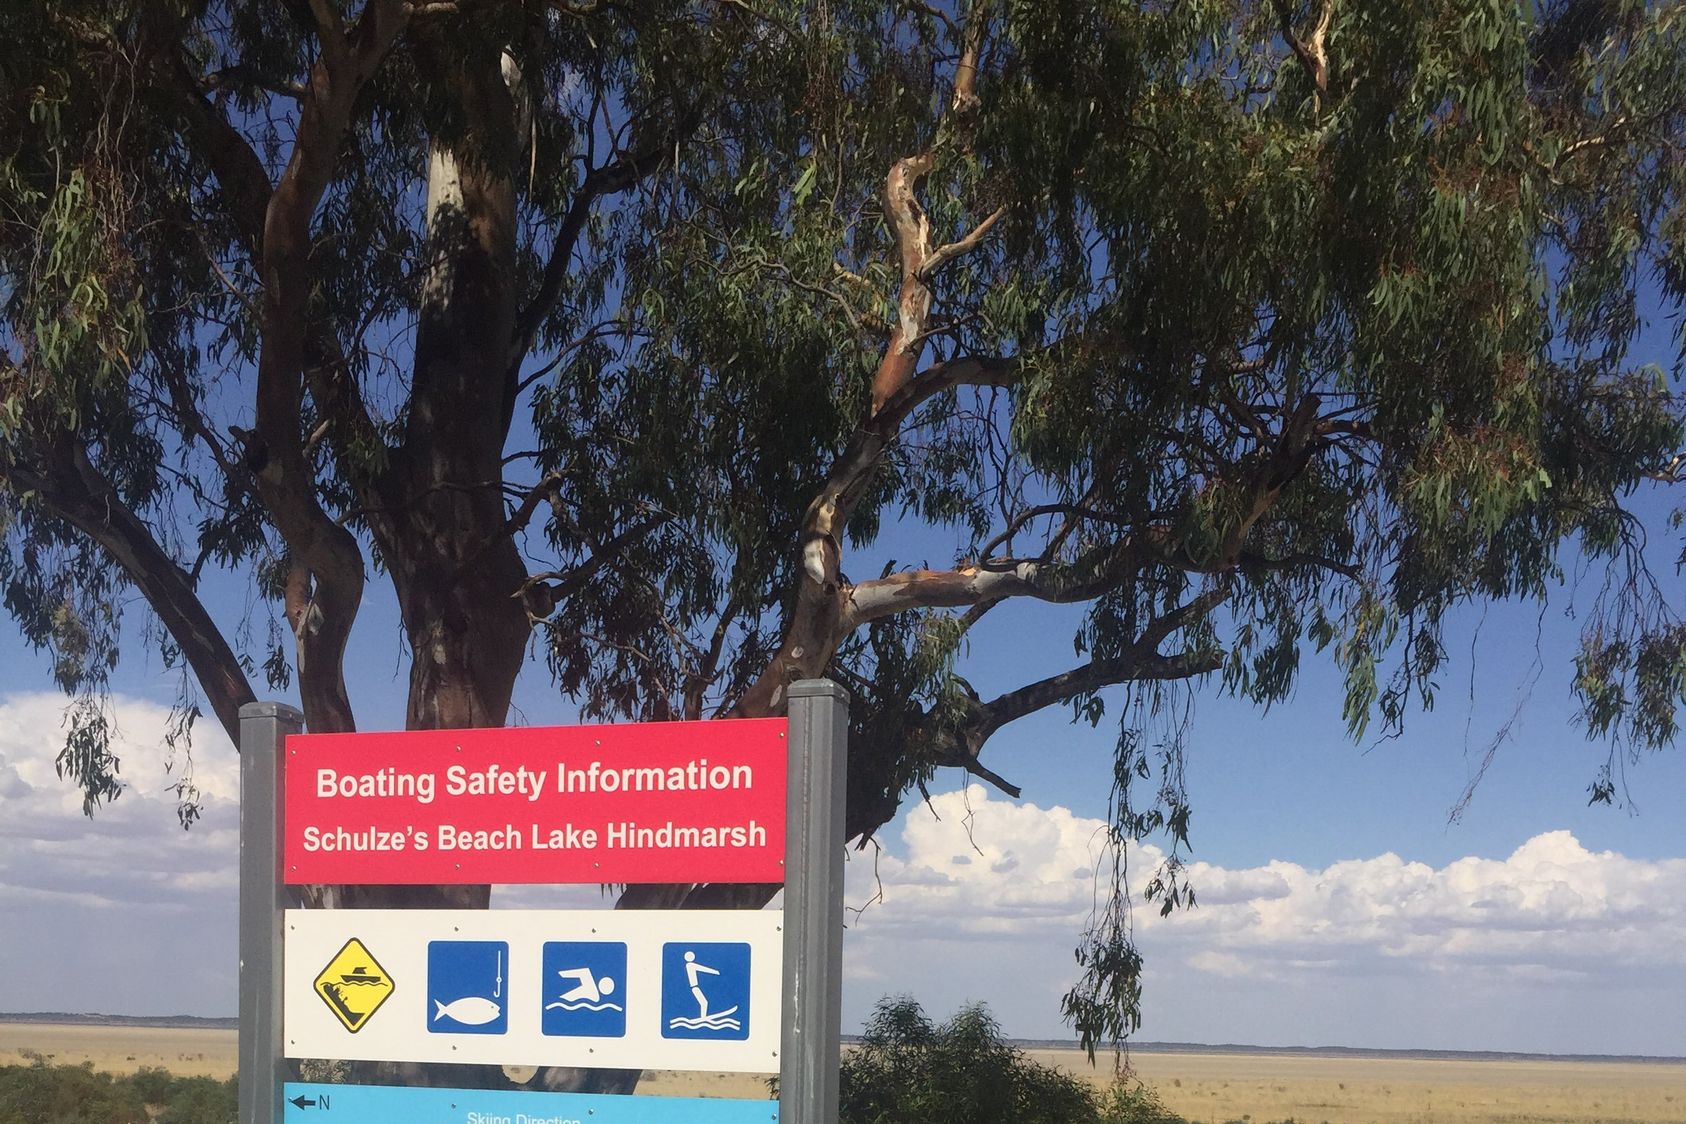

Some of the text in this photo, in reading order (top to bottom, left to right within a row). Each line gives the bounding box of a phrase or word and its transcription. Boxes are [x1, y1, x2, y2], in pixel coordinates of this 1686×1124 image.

[316, 758, 753, 804] Boating Safety Information
[302, 820, 767, 852] Schulze's Beach Lake Hindmarsh
[318, 1095, 331, 1111] N
